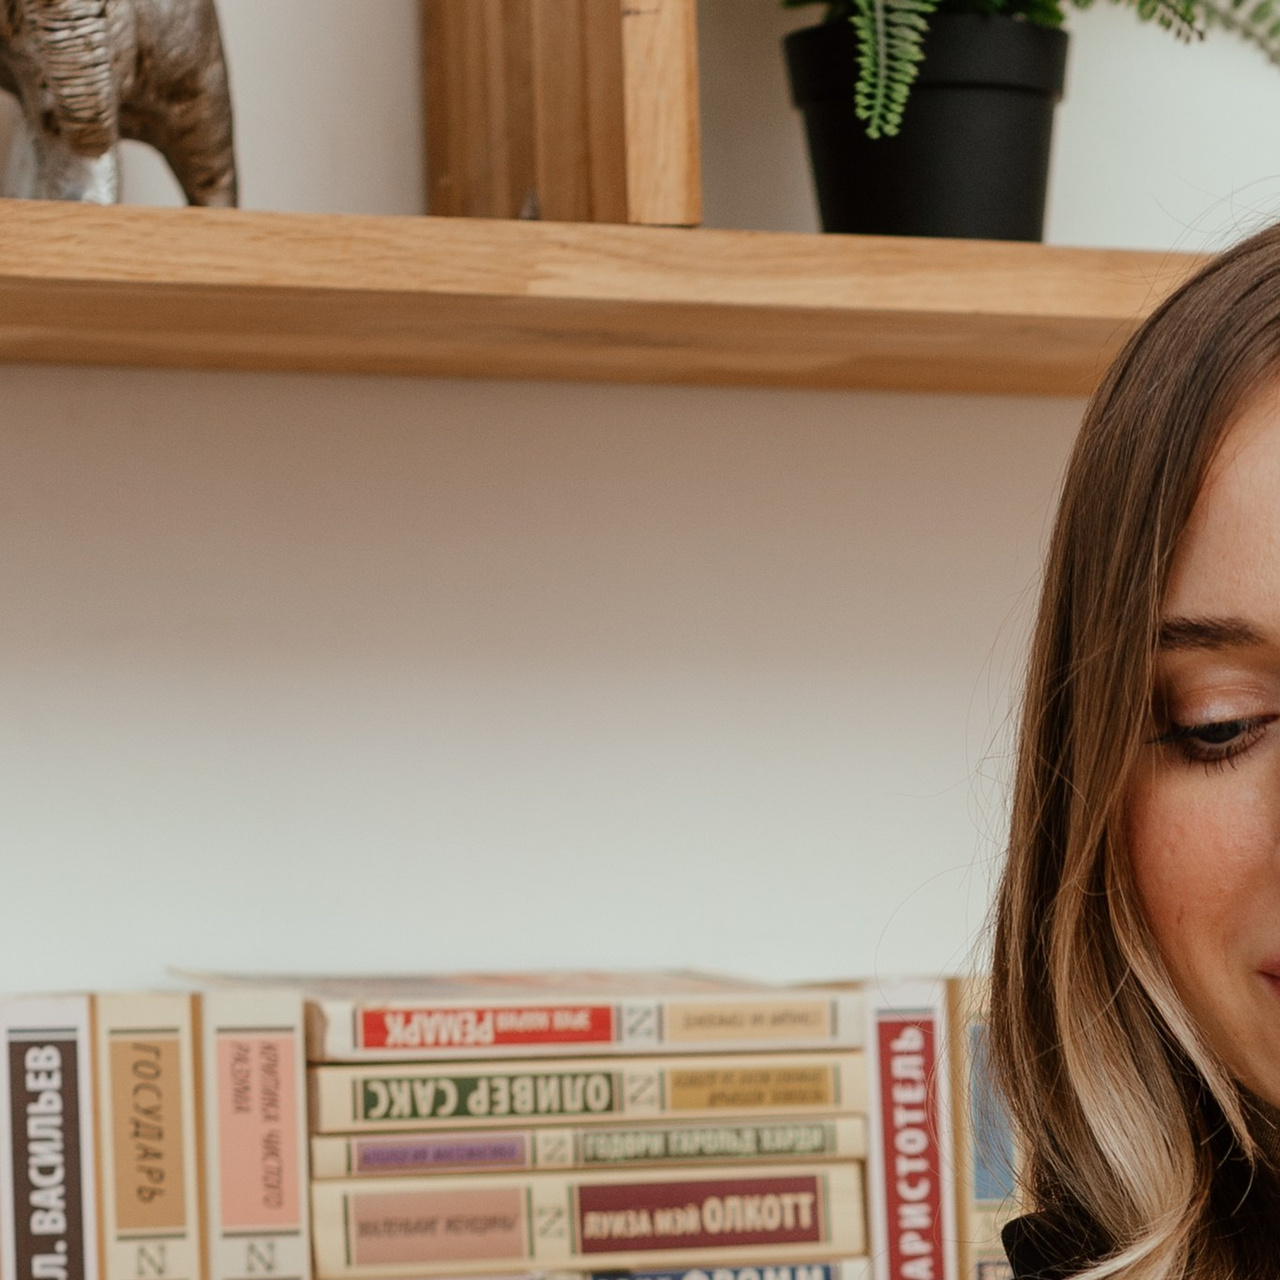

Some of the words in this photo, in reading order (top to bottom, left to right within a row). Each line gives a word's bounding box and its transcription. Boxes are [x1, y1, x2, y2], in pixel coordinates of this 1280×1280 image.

[385, 1010, 495, 1047] РЕМАРК
[368, 1078, 459, 1119] САКС
[467, 1074, 611, 1114] ОЛИВЕР
[25, 1044, 67, 1235] ВАСИЛЬЕВ
[132, 1041, 166, 1204] ГОСУДАРЬ
[890, 1026, 934, 1280] АРИСТОТЕЛЬ
[702, 1191, 815, 1234] ОЛКОТТ
